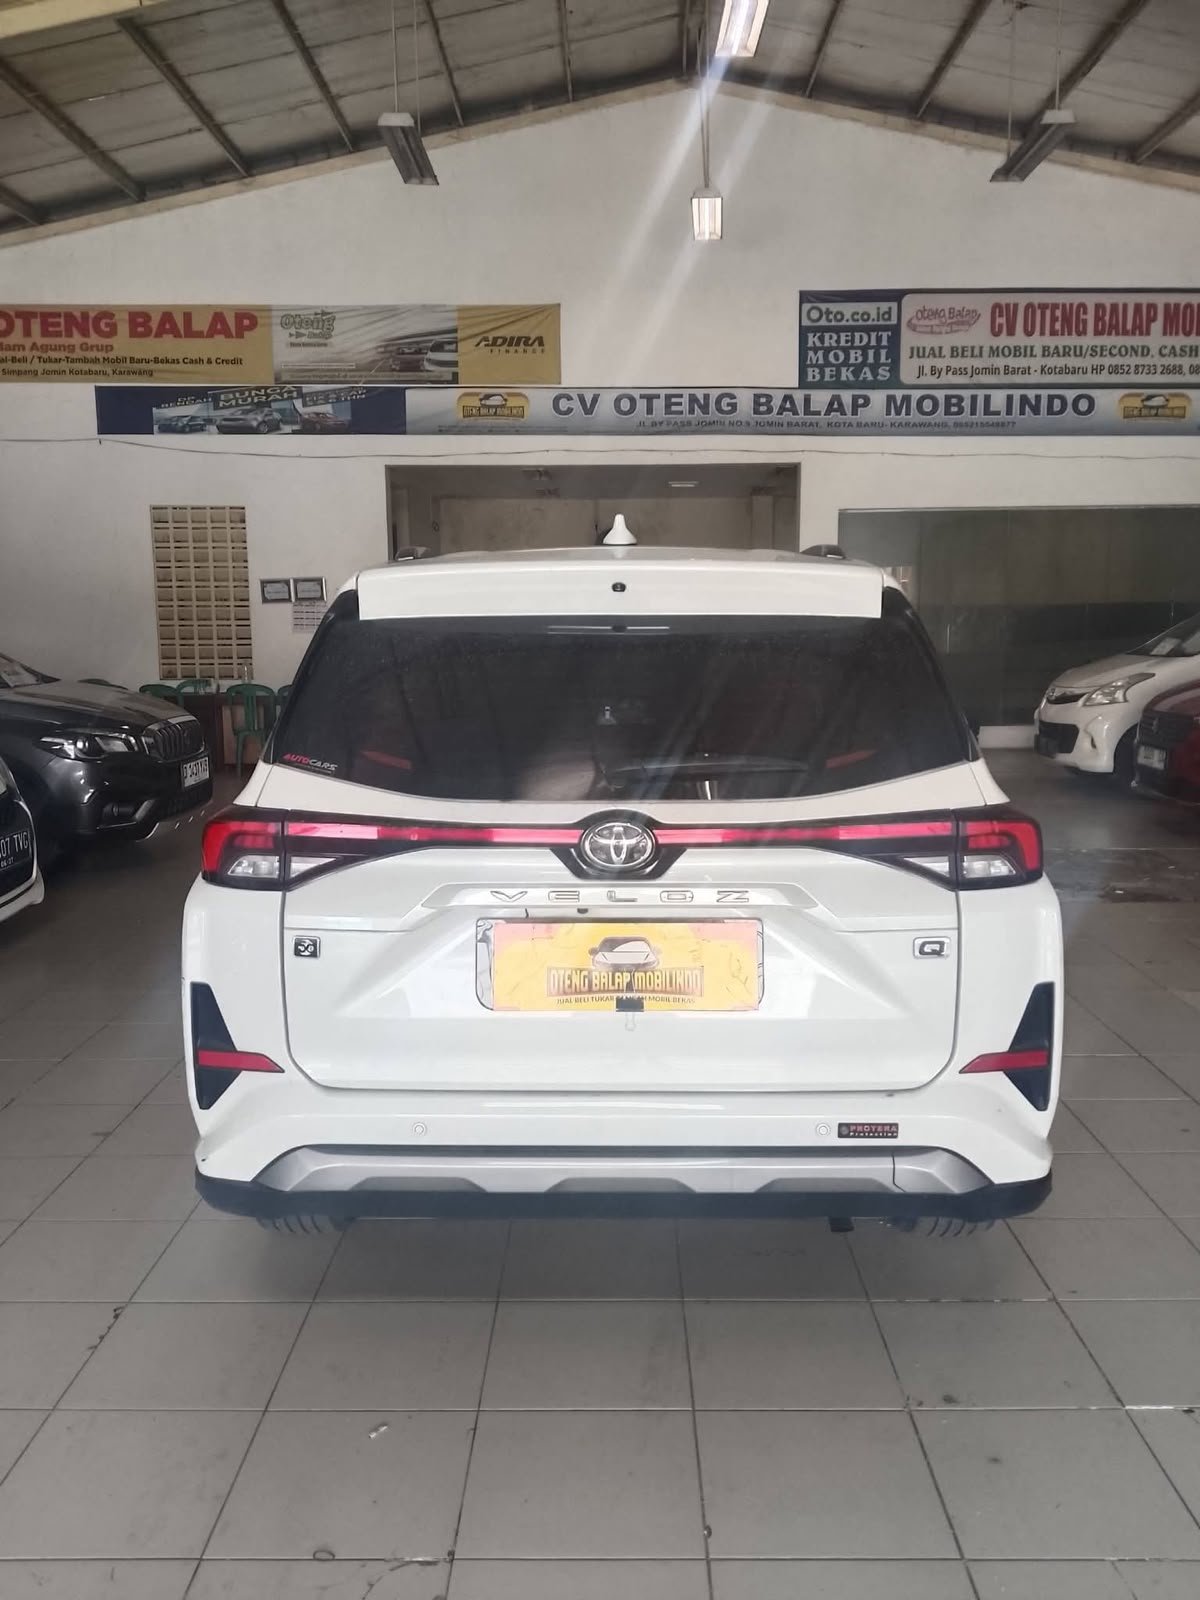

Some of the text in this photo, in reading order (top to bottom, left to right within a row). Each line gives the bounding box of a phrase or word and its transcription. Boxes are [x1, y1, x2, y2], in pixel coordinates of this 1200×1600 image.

[806, 305, 893, 323] Oto.co.id
[990, 302, 1019, 337] CV
[1023, 302, 1088, 337] OTENG
[1093, 302, 1158, 336] BALAP
[128, 311, 259, 339] BALAP
[475, 335, 545, 347] ADIRA
[806, 331, 892, 348] KREDIT
[30, 342, 76, 354] Agung
[80, 342, 114, 354] Grup
[909, 345, 946, 359] JUAL
[949, 345, 984, 359] BELI
[988, 345, 1038, 359] MOBIL
[1158, 345, 1199, 358] CASH
[37, 356, 100, 365] Tukar-Tambah
[103, 356, 127, 365] Mobil
[129, 356, 180, 365] Baru-Bekas
[182, 357, 204, 365] Cash
[206, 357, 213, 365] &
[215, 357, 243, 365] Credit
[806, 349, 892, 365] MOBIL
[2, 368, 153, 377] Simpang Jomin Kotabaru, Karawang
[806, 366, 891, 382] BEKAS
[916, 364, 928, 379] Jl.
[930, 365, 943, 379] By
[945, 365, 969, 376] Pass
[970, 364, 1000, 378] Jomin
[1003, 364, 1031, 375] Barat
[1040, 363, 1088, 375] Kotabaru
[1091, 364, 1105, 375] HP
[1107, 364, 1132, 375] 0852
[1134, 364, 1157, 375] 8733
[219, 391, 298, 408] MURAH
[552, 392, 600, 416] CV
[613, 392, 738, 416] OTENG
[752, 392, 872, 417] BALAP
[885, 393, 1096, 417] MOBILINDO
[282, 753, 339, 771] AUTOCARS
[0, 837, 11, 858] 07
[490, 890, 750, 903] VELOZ
[550, 969, 702, 996] OTENG BALAP MOBILINDO
